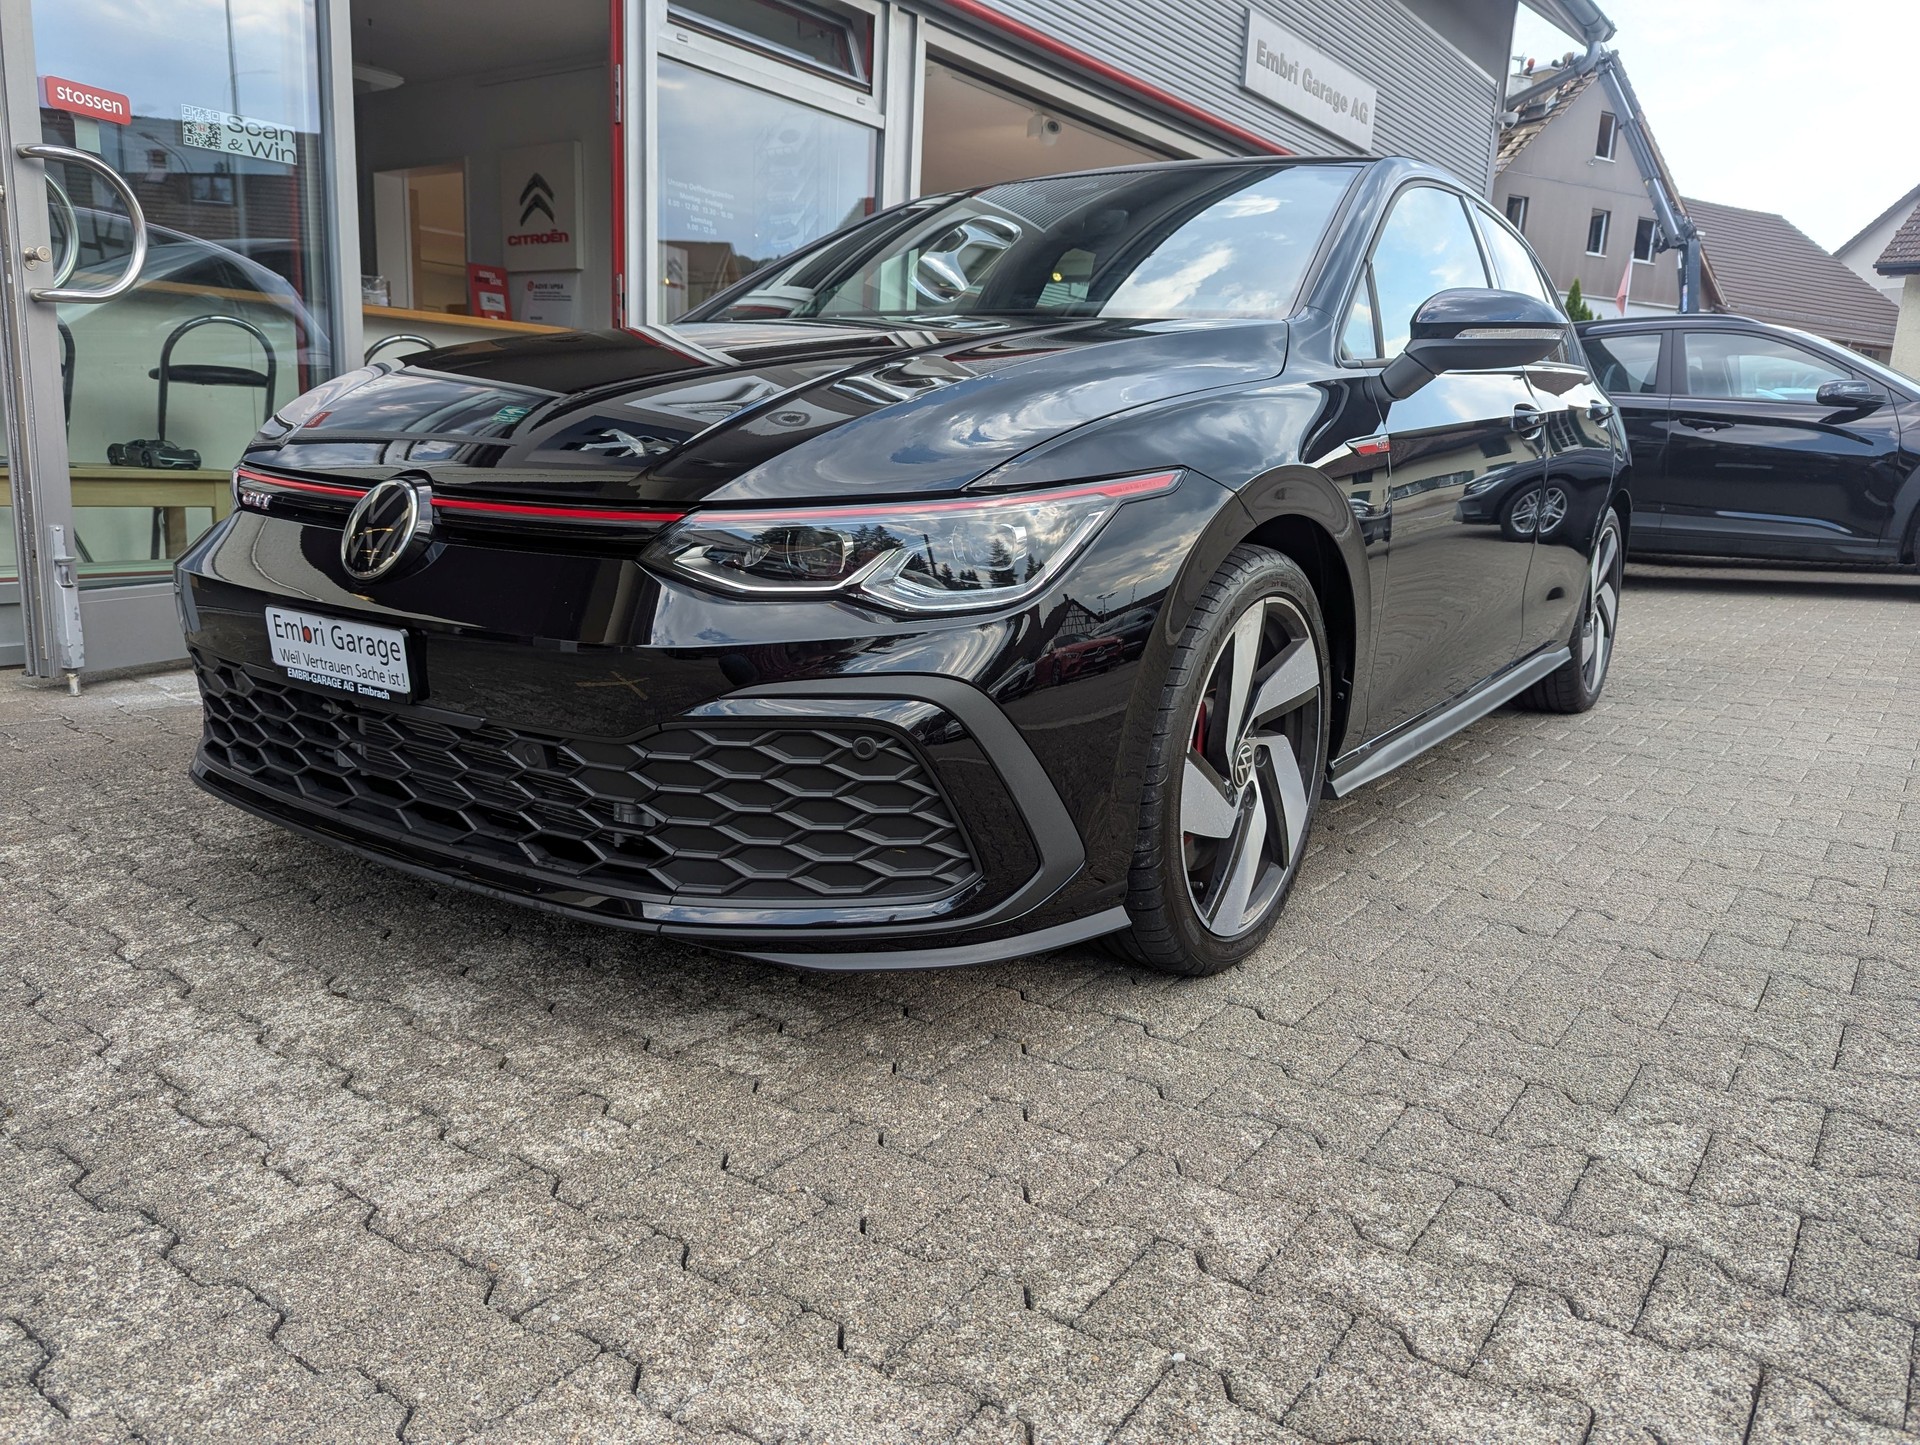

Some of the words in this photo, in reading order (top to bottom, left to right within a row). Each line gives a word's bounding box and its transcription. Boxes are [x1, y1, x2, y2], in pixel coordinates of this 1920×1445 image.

[1256, 38, 1299, 86] Embri
[1302, 67, 1348, 114] Garage
[1350, 97, 1369, 125] AG
[56, 85, 123, 116] stossen
[226, 115, 297, 145] Scan
[226, 138, 243, 152] &
[247, 138, 297, 164] Win
[272, 613, 326, 647] Embri
[330, 625, 402, 667] Garage
[279, 647, 301, 666] Weil
[302, 652, 354, 677] Vertrauen
[356, 663, 386, 683] Sache
[287, 667, 343, 690] EMBRI-GARAGE
[343, 681, 355, 693] AG
[357, 685, 391, 701] Embrach
